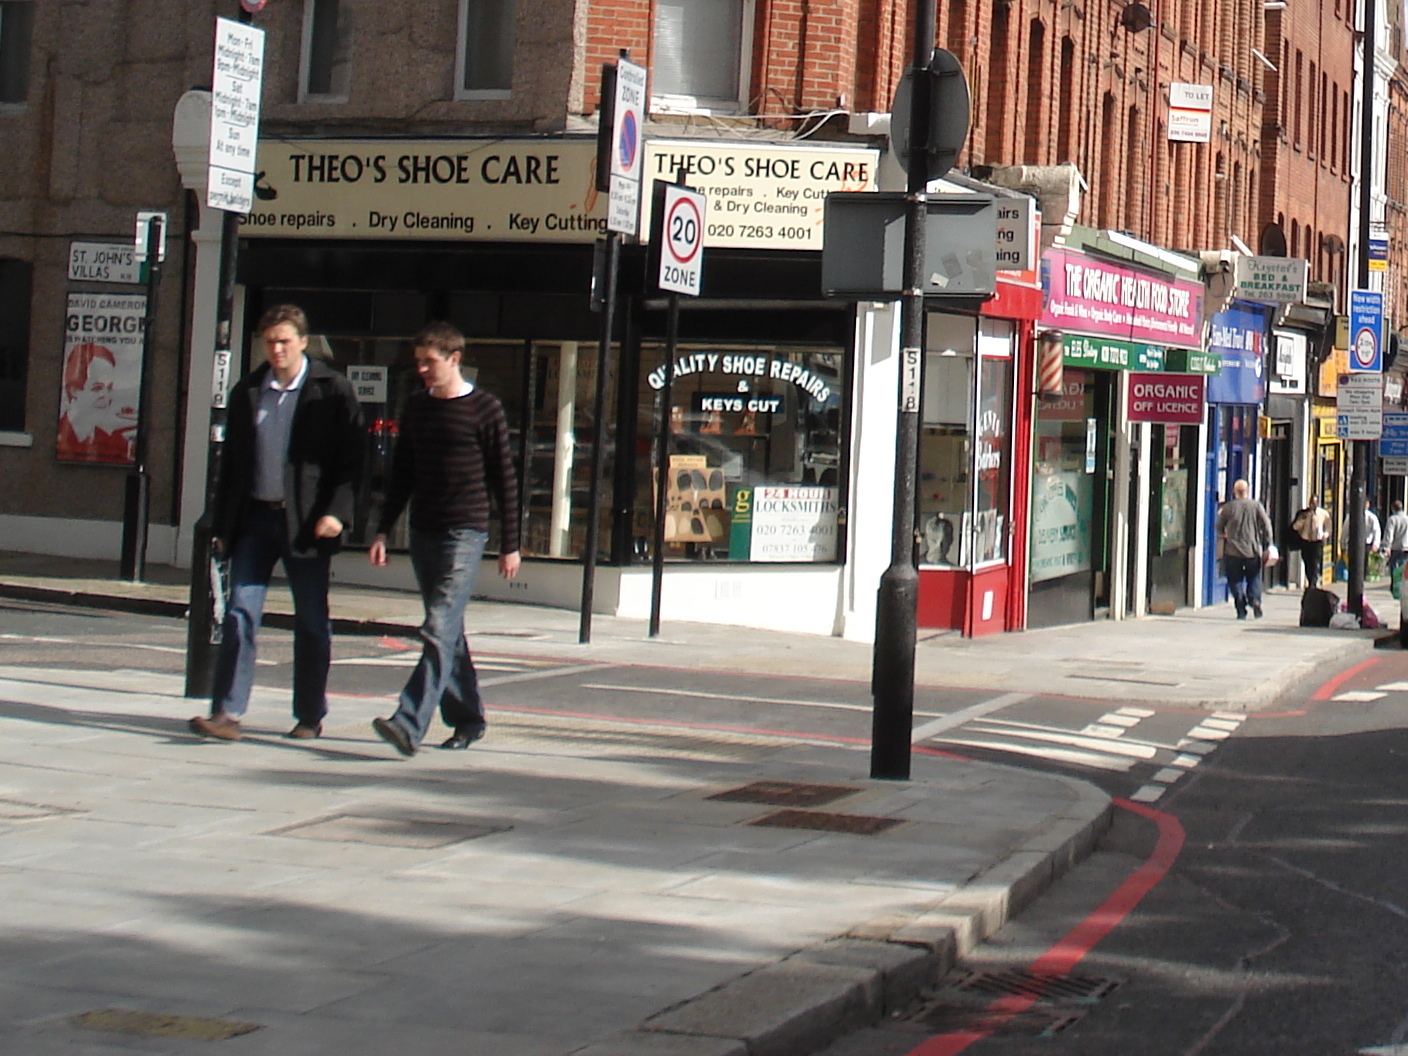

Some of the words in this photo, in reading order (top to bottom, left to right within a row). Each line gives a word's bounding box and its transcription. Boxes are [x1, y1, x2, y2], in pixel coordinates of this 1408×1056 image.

[621, 86, 640, 106] ZONE
[1184, 91, 1194, 99] TO
[1196, 92, 1210, 100] LET
[228, 127, 240, 140] Sun
[225, 144, 236, 156] any
[237, 145, 250, 157] time
[289, 154, 387, 184] THEO'S
[398, 155, 470, 184] SHOE
[480, 155, 560, 184] CARE
[654, 153, 735, 176] THEO'S
[744, 157, 801, 179] SHOE
[809, 161, 869, 182] CARE
[221, 172, 242, 188] Except
[709, 185, 753, 198] repairs
[776, 187, 799, 200] Key
[713, 200, 722, 211] &
[727, 201, 750, 215] Dry
[753, 201, 808, 217] Cleaning
[280, 210, 335, 230] repairs
[369, 211, 398, 232] Dry
[403, 212, 474, 232] Cleaning
[509, 214, 540, 234] Key
[545, 214, 608, 234] Cutting
[673, 216, 696, 244] 20
[707, 225, 734, 237] 020
[739, 225, 773, 238] 7263
[778, 226, 812, 240] 4001
[93, 251, 133, 266] JOHN'S
[72, 265, 110, 279] VILLAS
[1247, 259, 1298, 274] Krystal's
[664, 266, 696, 288] ZONE
[1253, 274, 1275, 282] BED
[1065, 263, 1082, 297] THE
[1083, 268, 1120, 304] ORGANIC
[1121, 276, 1150, 309] HEALTH
[1150, 281, 1168, 313] FOOD
[1168, 287, 1190, 318] STORE
[1240, 281, 1301, 292] BREAKFAST
[68, 299, 98, 309] DAVID
[1352, 293, 1365, 302] New
[1366, 294, 1381, 303] width
[1353, 305, 1380, 314] restriction
[1358, 315, 1375, 324] ahead
[722, 355, 766, 375] SHOE
[770, 360, 830, 403] REPAIRS
[737, 380, 749, 393] &
[1133, 383, 1199, 399] ORGANIC
[701, 397, 743, 411] KEYS
[747, 399, 780, 413] CUT
[1133, 401, 1153, 412] OFF
[1157, 402, 1199, 413] LICENCE
[755, 500, 836, 513] LOCKSMITHS
[757, 525, 777, 535] 020
[780, 525, 805, 535] 7263
